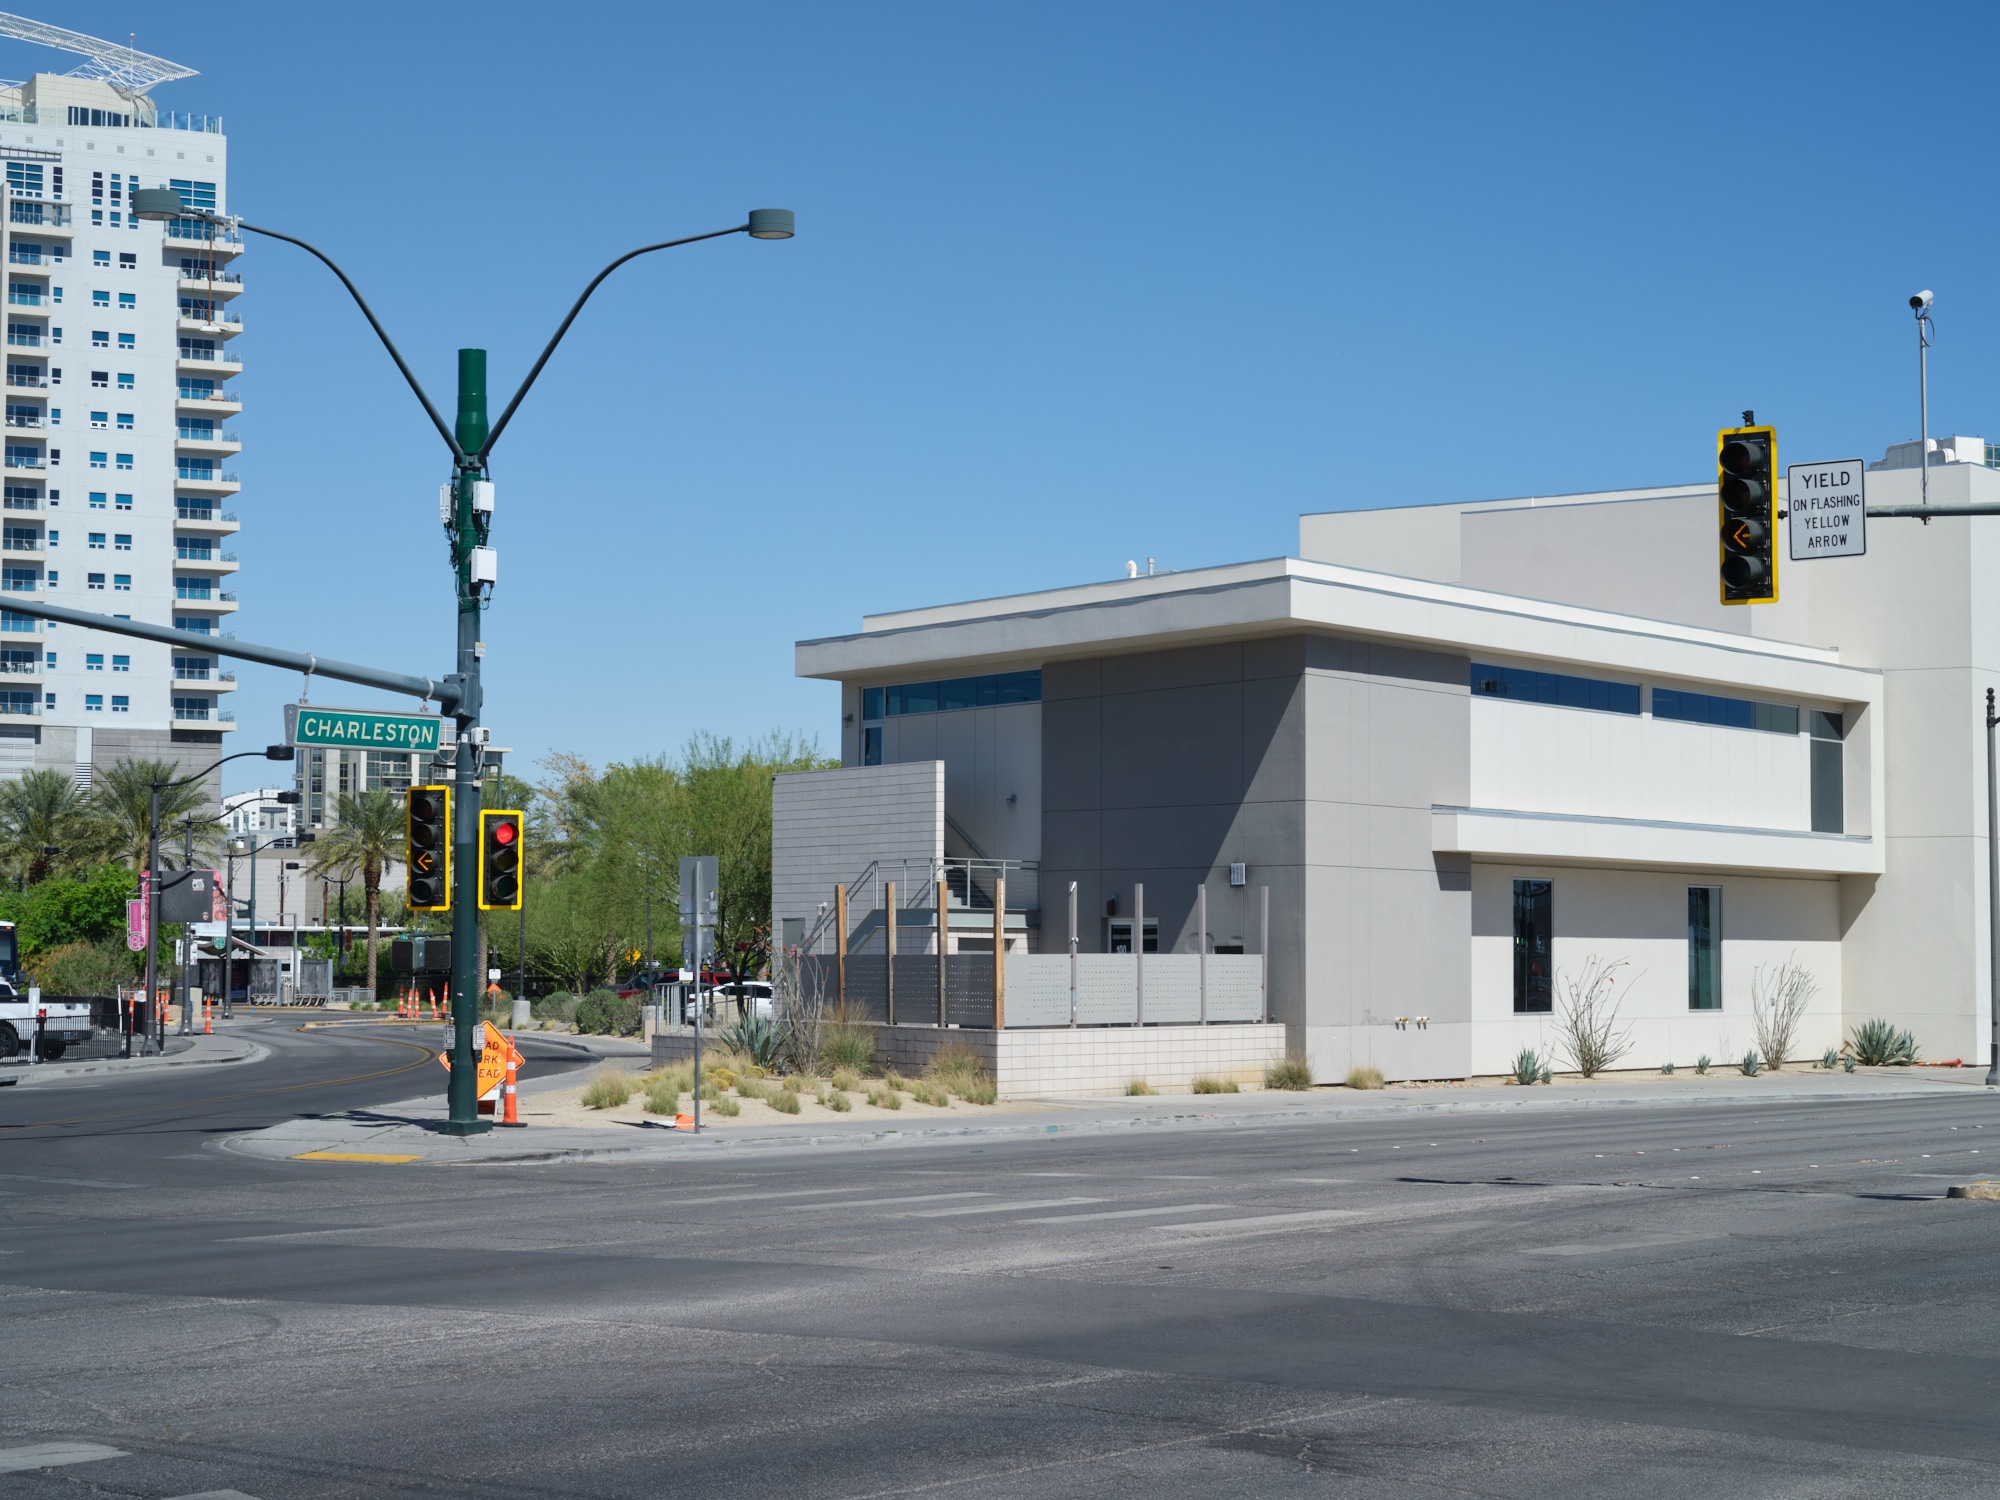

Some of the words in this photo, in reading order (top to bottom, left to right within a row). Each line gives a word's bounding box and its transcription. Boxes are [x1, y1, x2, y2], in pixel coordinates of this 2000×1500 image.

[1802, 471, 1850, 489] YIELD
[1793, 499, 1807, 511] ON
[1811, 494, 1860, 510] FLASHING
[1804, 514, 1850, 529] YELLOW
[1808, 534, 1848, 548] ARROW
[304, 717, 434, 743] CHARLESTON
[484, 1041, 500, 1051] AD
[484, 1055, 498, 1065] RK
[478, 1069, 501, 1079] EAD
